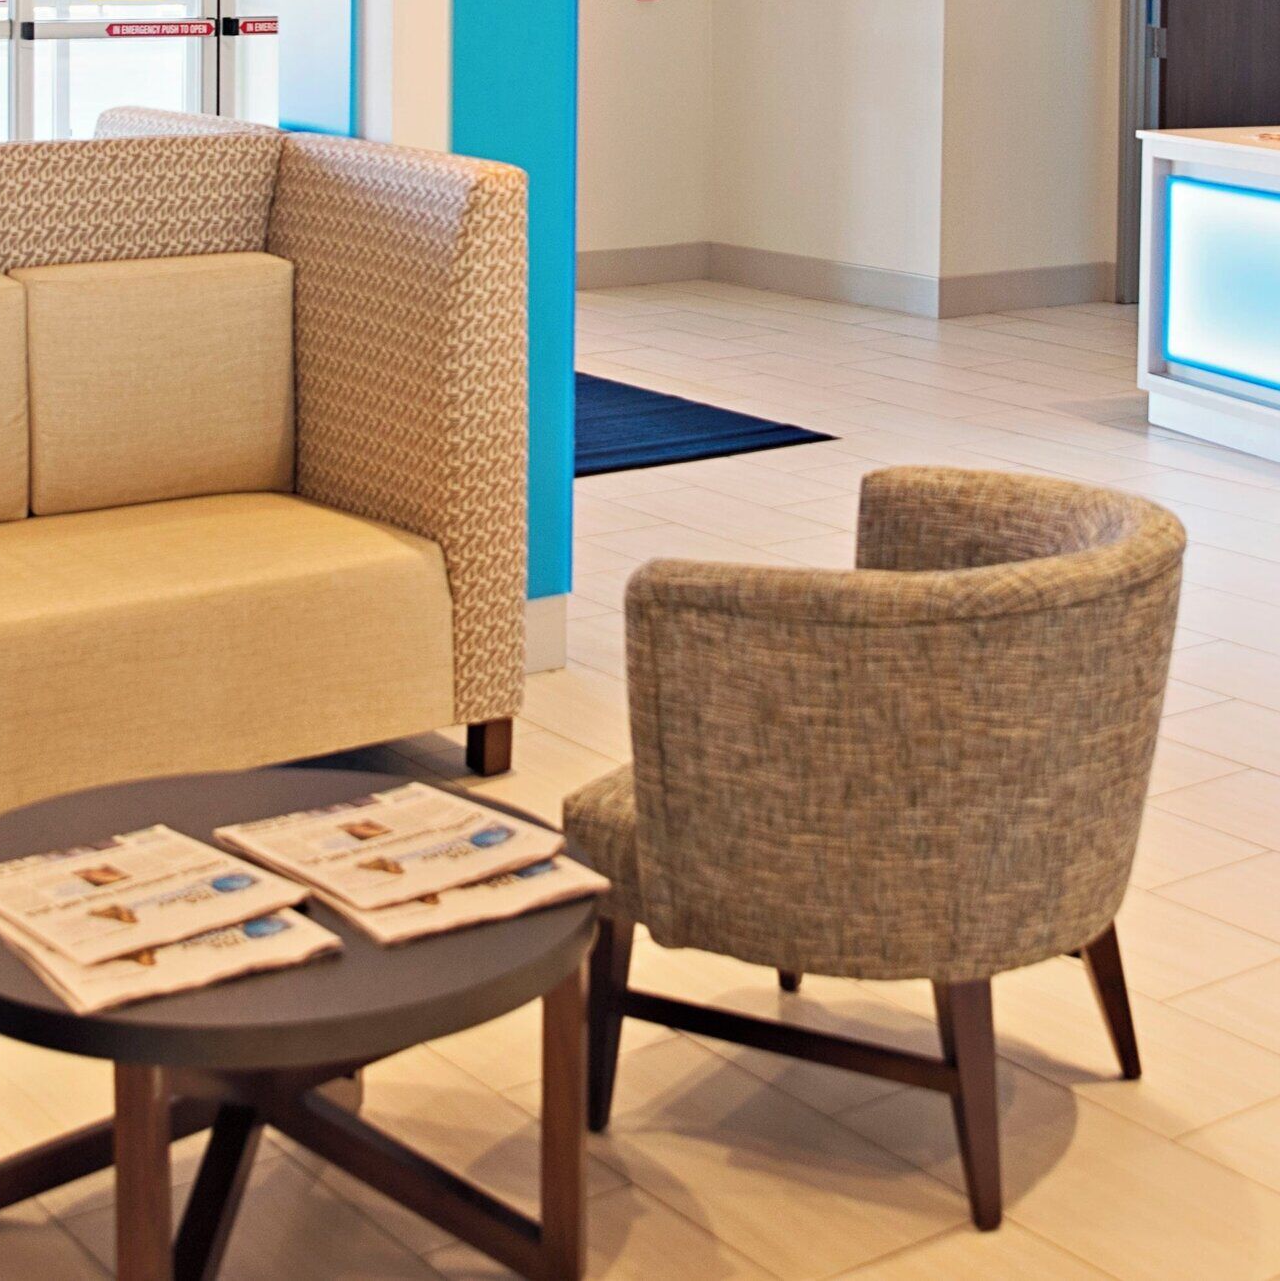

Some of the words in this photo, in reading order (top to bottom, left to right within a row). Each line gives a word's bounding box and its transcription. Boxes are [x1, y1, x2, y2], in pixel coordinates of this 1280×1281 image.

[121, 25, 161, 34] EMERGENCY
[161, 24, 179, 34] PUSH
[190, 24, 208, 33] OPEN
[255, 22, 278, 32] EMERG
